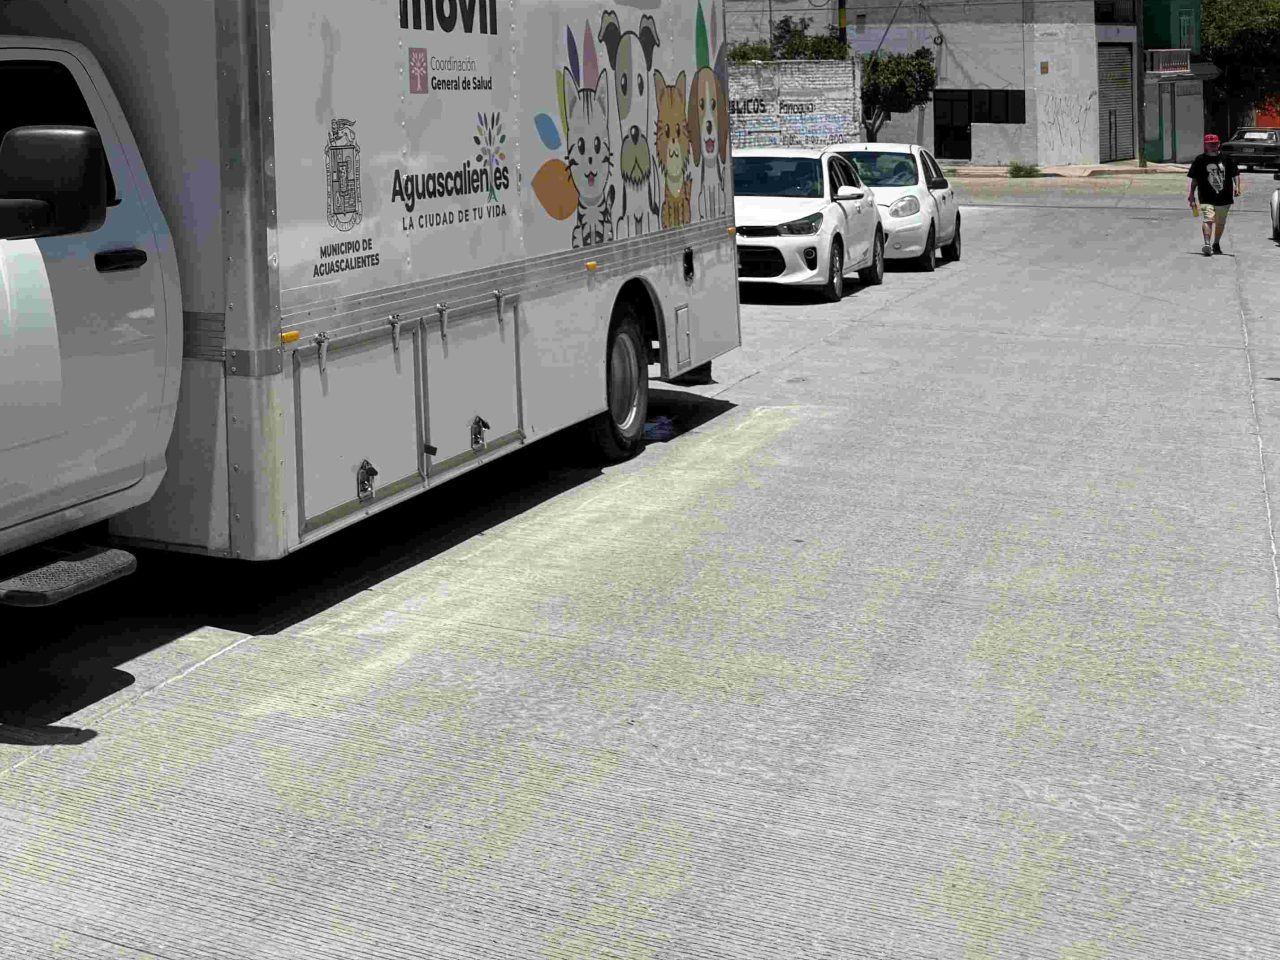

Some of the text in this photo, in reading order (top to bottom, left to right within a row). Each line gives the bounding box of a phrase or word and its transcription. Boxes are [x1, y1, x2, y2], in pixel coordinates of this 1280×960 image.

[431, 56, 477, 71] Coordinación
[431, 76, 492, 90] General de Salud
[402, 204, 507, 231] LA CIUDAD DE TU VIDA
[320, 238, 373, 259] MUNICIPIO DE
[313, 253, 380, 278] AGUASCALIENTES
